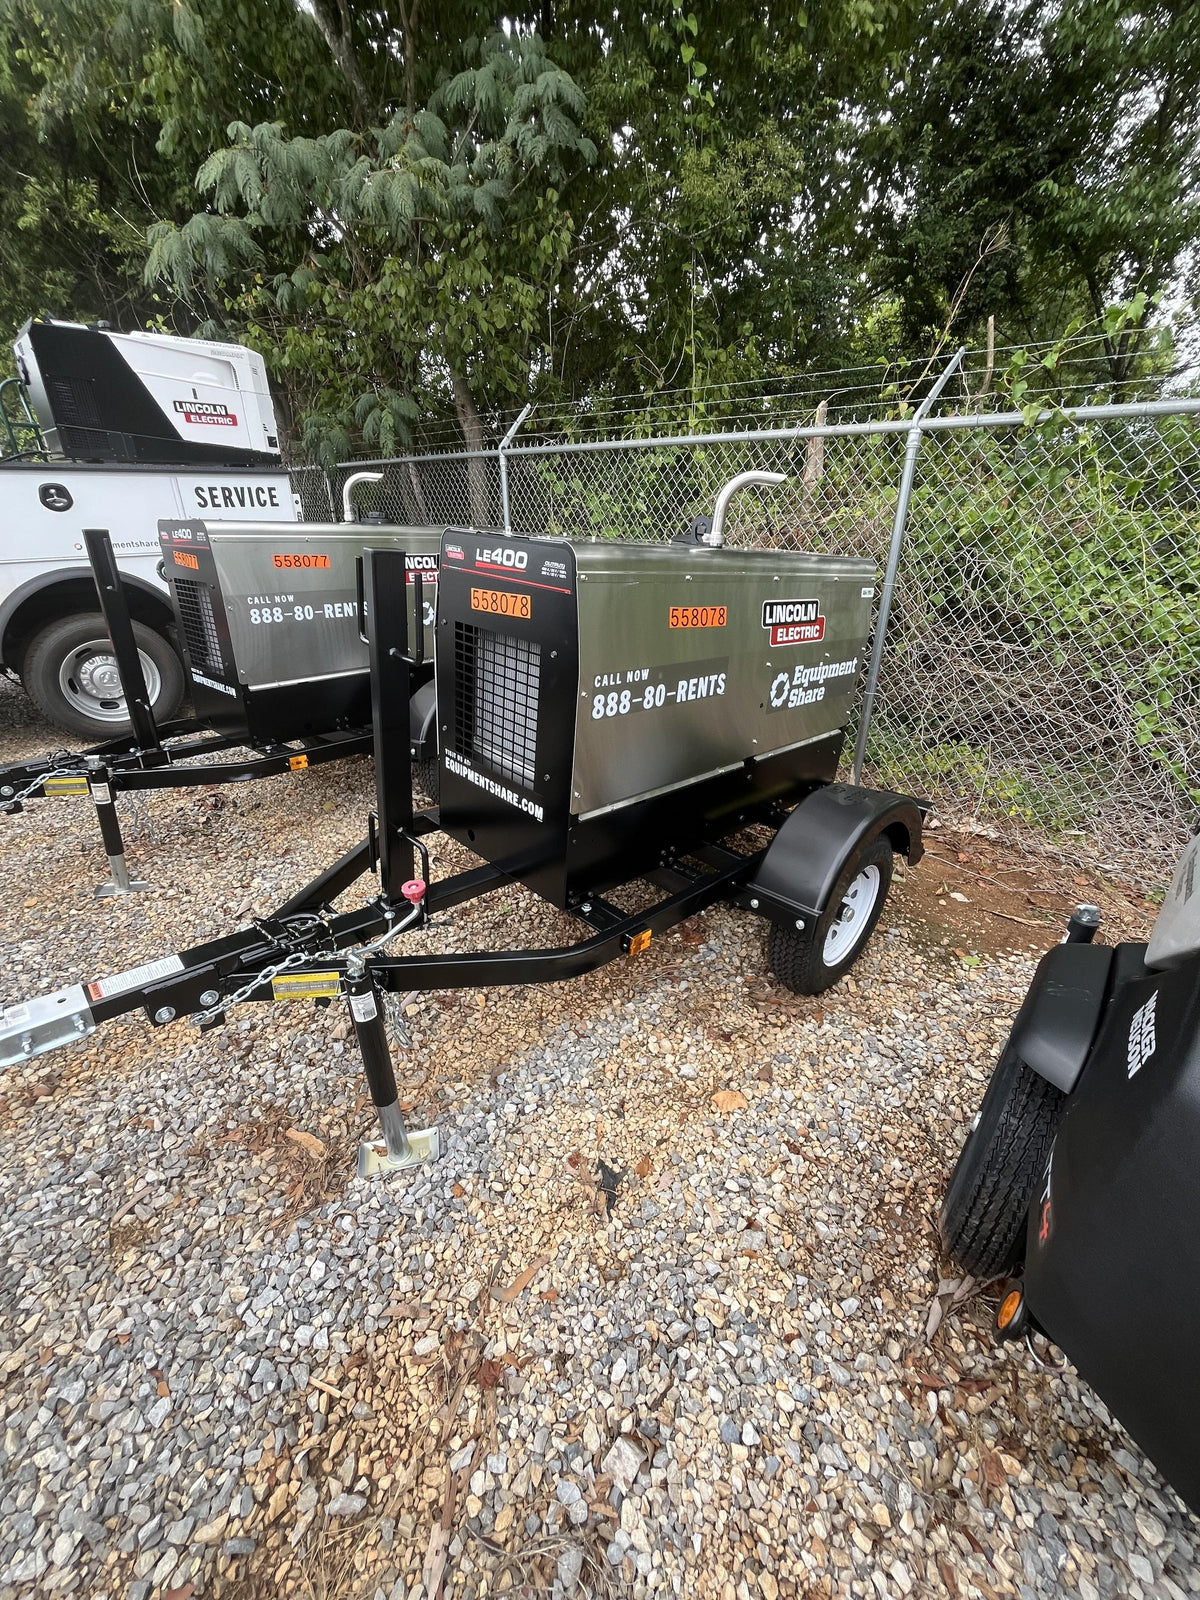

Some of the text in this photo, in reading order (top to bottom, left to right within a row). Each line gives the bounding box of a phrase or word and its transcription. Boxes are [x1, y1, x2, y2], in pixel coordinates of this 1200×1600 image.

[175, 402, 227, 416] LINCOLN
[190, 415, 234, 426] ELECTRIC
[194, 486, 280, 509] SERVICE
[112, 540, 159, 550] mentshare
[273, 554, 328, 569] 558077
[405, 556, 437, 570] NCOL
[475, 547, 528, 569] LE400
[408, 571, 439, 582] EECT
[247, 594, 294, 605] CALL NOW
[472, 589, 529, 617] 558078
[671, 607, 726, 628] 558078
[764, 603, 817, 625] LINCOLN
[776, 624, 820, 642] ELECTRIC
[594, 668, 650, 689] CALL NOW
[793, 658, 858, 686] Equipment
[591, 673, 727, 720] 888-80-RENTS
[787, 683, 826, 708] Share
[445, 756, 544, 820] EQUIPMENTSHARE.COM
[1142, 989, 1158, 1065] WACKER
[1127, 1005, 1145, 1080] NEUSON
